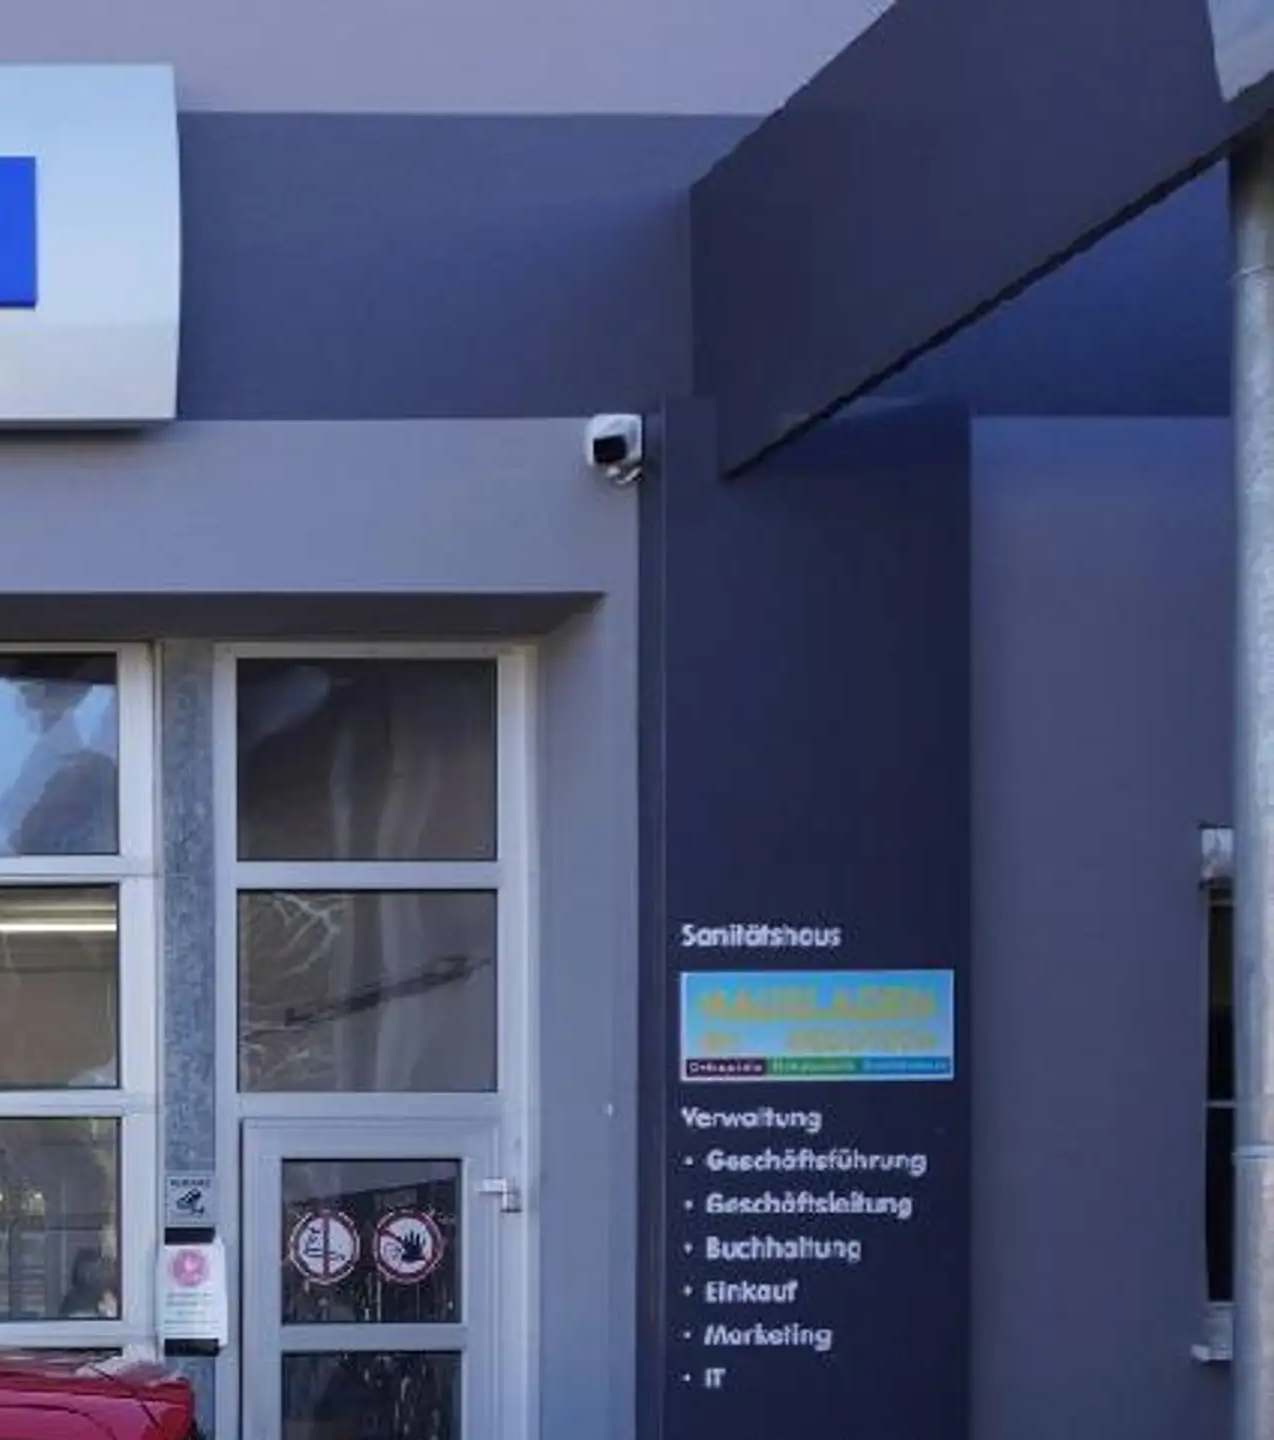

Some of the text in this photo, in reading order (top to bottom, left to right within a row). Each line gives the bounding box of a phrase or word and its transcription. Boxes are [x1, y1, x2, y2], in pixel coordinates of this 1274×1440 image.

[682, 924, 840, 946] Sanitätshaus
[681, 1107, 821, 1133] Verwaltung
[706, 1148, 926, 1176] Geschäftsführung
[706, 1191, 912, 1218] Geschäftsleitung
[707, 1236, 860, 1260] Buchhaltung
[706, 1281, 797, 1302] Einkauf
[704, 1323, 831, 1351] Marketing
[706, 1368, 725, 1388] IT
